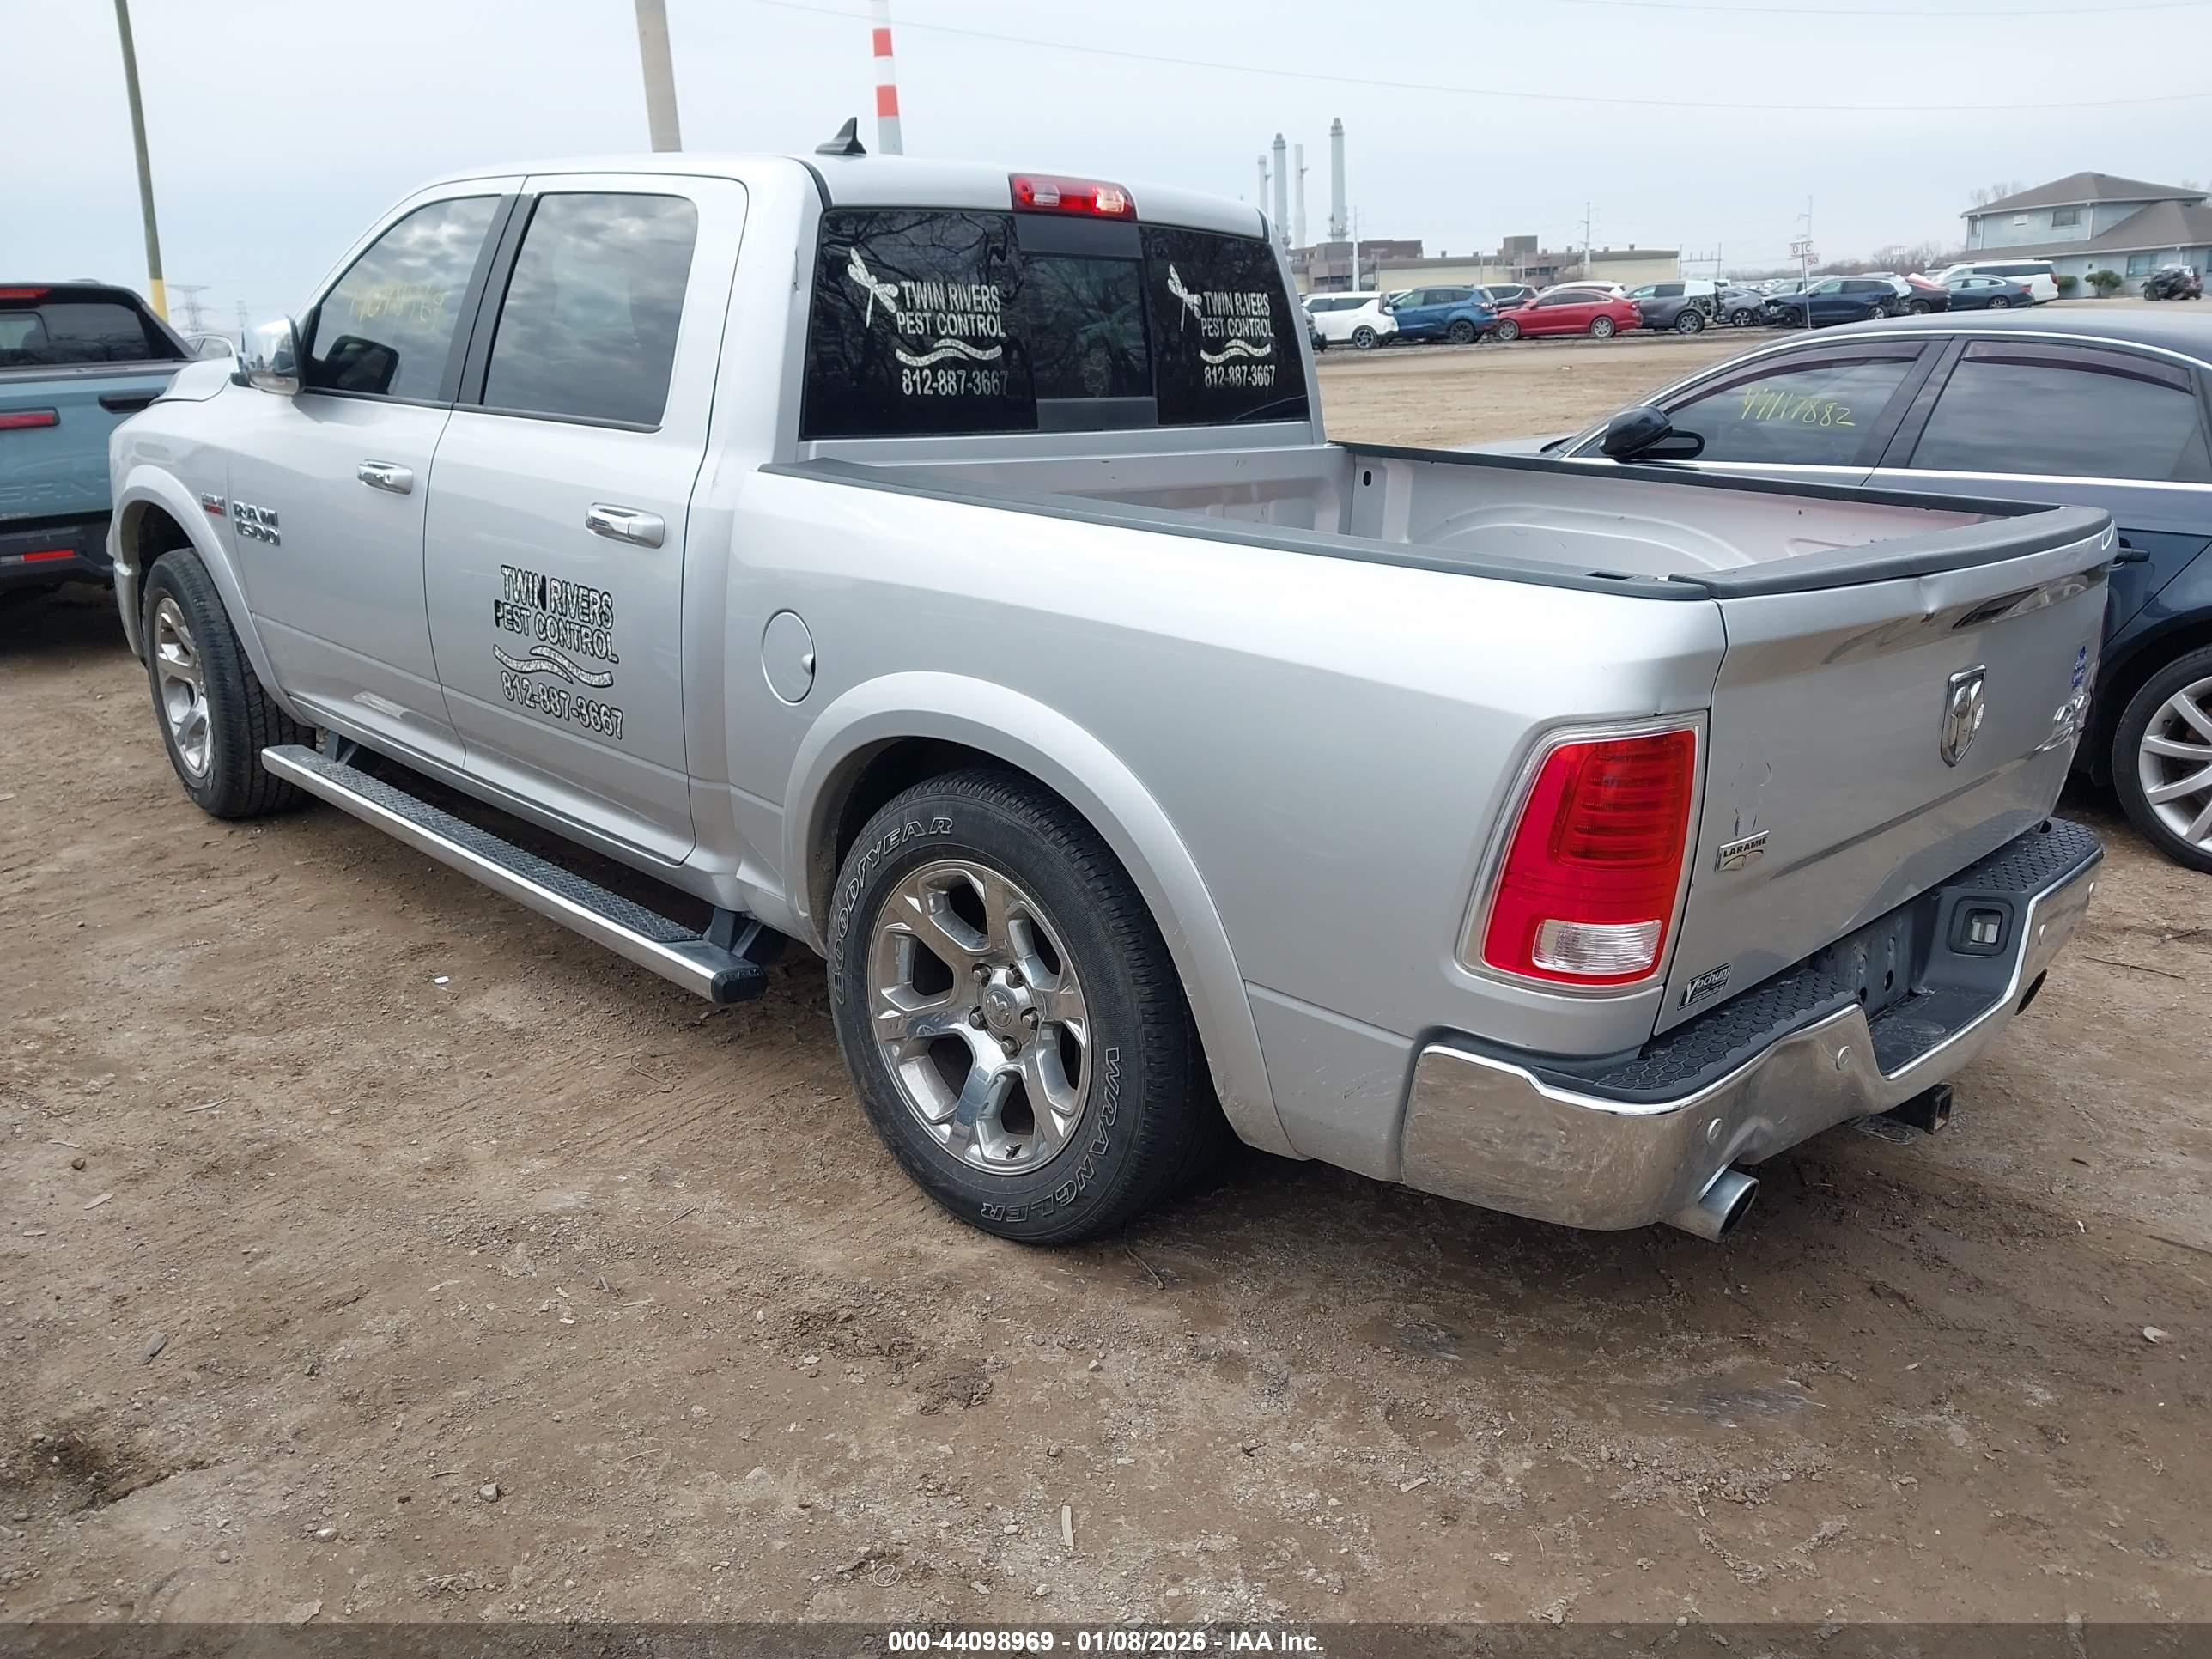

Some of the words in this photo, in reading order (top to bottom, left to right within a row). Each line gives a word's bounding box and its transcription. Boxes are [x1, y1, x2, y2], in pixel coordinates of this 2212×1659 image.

[900, 281, 945, 311] TWIN
[947, 283, 1001, 313] RIVERS
[1202, 291, 1234, 316] TWIN
[896, 311, 932, 335] PEST
[936, 313, 1006, 337] CONTROL
[1200, 317, 1224, 337] PEST
[1227, 318, 1275, 337] CONTROL
[902, 368, 1009, 396] 812-887-3667
[1204, 364, 1276, 387] 812-887-3667
[233, 500, 279, 528] RAM
[234, 518, 281, 547] 1500
[501, 564, 547, 611] TWIN
[550, 578, 614, 629] RIVERS
[494, 599, 532, 636] PEST
[534, 611, 619, 665] CONTROL
[501, 671, 624, 741] 812-887-3667
[1723, 836, 1768, 858] LARAMIE
[834, 817, 954, 1006] GOODYEAR
[1684, 966, 1731, 1005] Yochum
[980, 1046, 1121, 1223] WRANGLER
